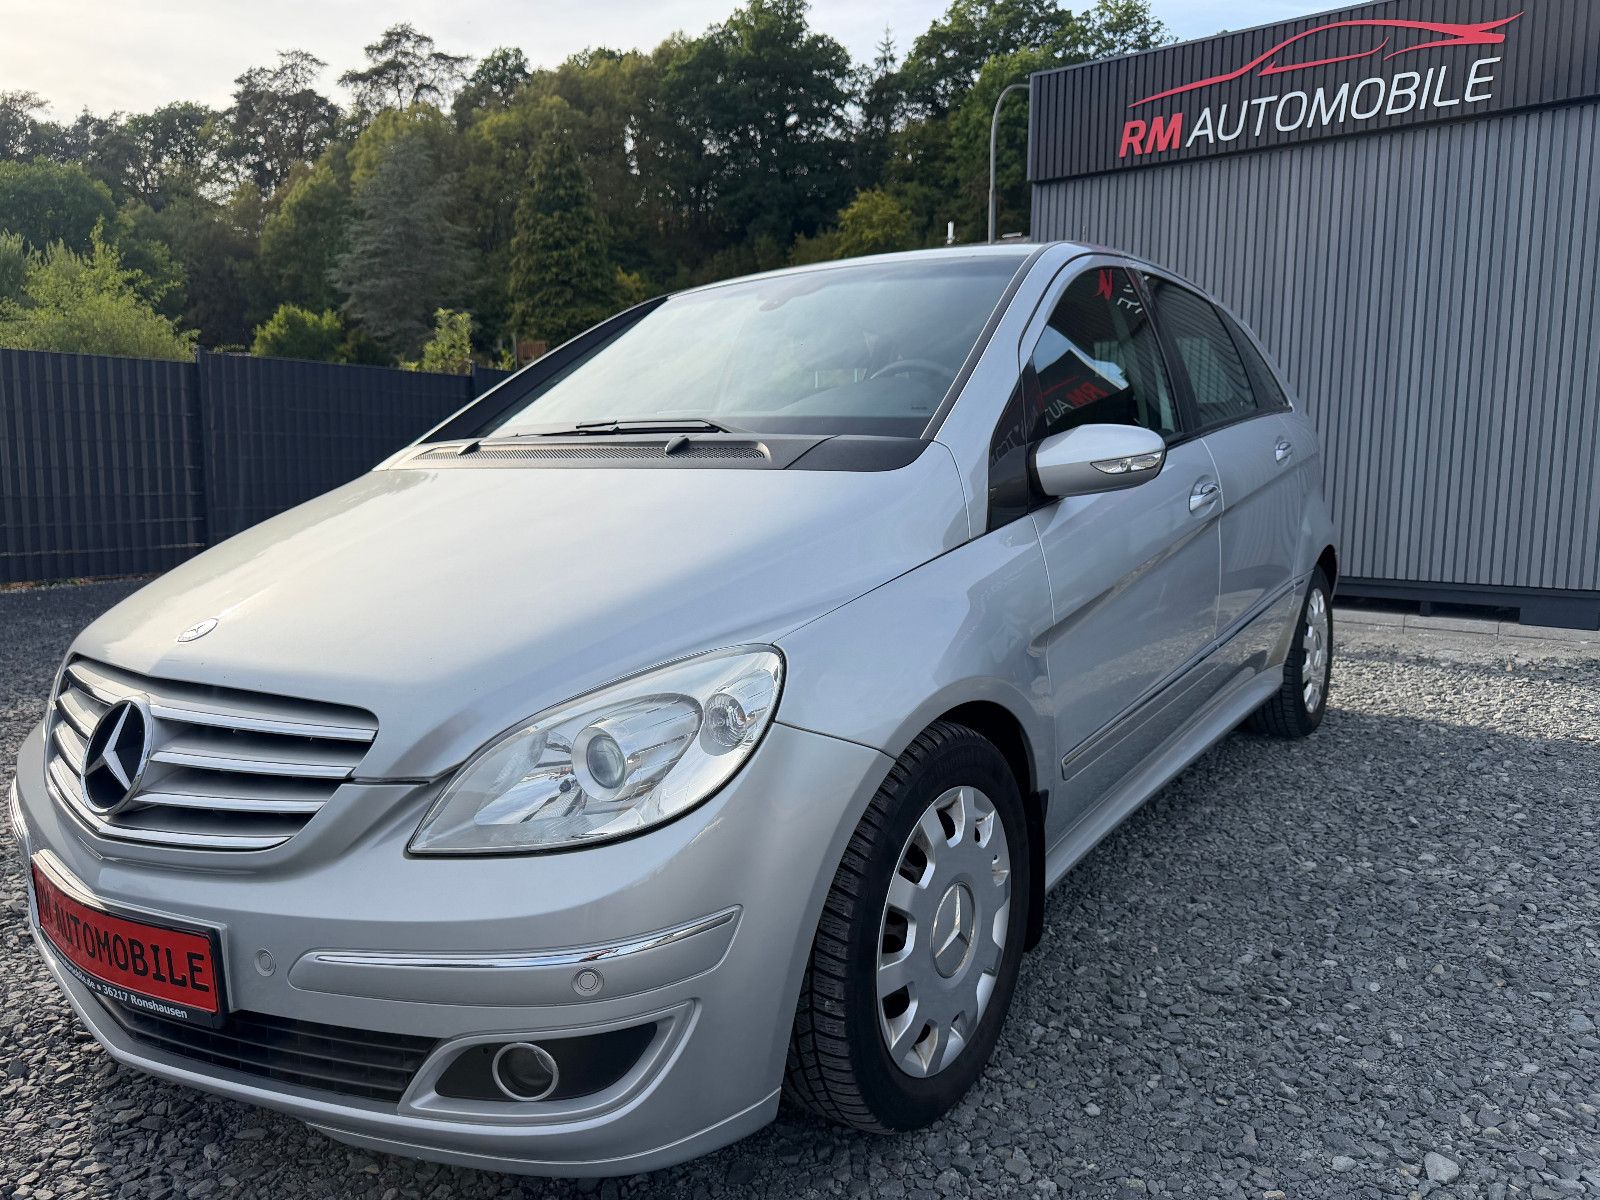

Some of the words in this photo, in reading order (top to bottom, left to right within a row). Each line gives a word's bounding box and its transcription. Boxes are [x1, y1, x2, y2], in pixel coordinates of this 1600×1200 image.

[1118, 113, 1184, 158] RM
[1185, 57, 1502, 148] AUTOMOBILE
[54, 901, 209, 993] AUTOMOBILE
[102, 984, 128, 1002] 36217
[130, 994, 188, 1019] Ronshausen
